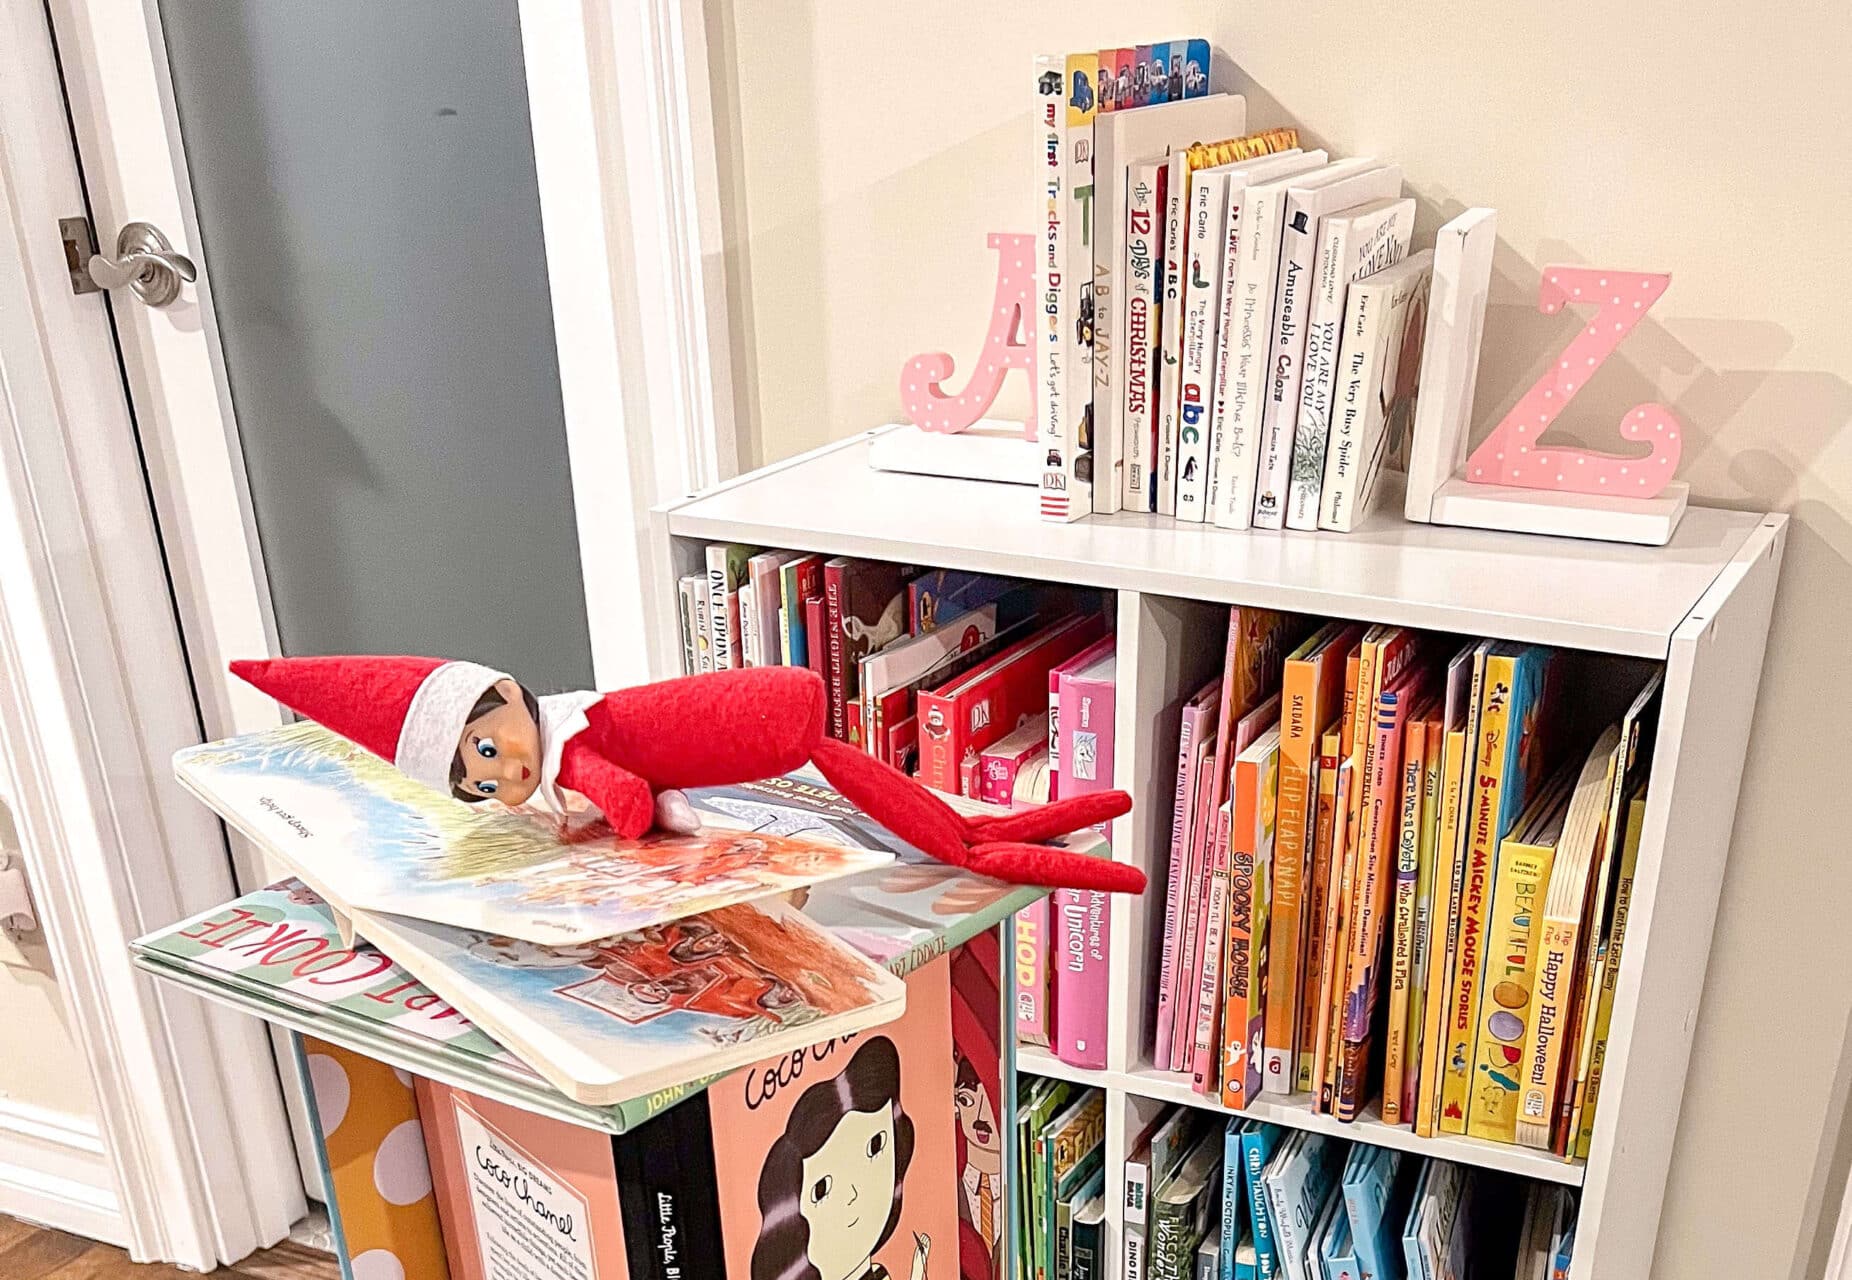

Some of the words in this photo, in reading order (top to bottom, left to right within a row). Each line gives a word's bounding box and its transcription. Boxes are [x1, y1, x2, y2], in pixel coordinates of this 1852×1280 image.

[1044, 103, 1056, 128] my
[1199, 186, 1209, 207] Eric
[1130, 208, 1151, 235] 12
[1048, 243, 1058, 269] and
[1280, 260, 1303, 346] Amuseable
[1306, 334, 1320, 373] LOVE
[1322, 321, 1335, 353] YOU
[1048, 352, 1060, 378] Let's
[1094, 327, 1110, 388] JAY-Z
[1317, 353, 1331, 388] ARE
[1350, 351, 1364, 376] The
[1303, 375, 1316, 408] YOU
[1314, 388, 1328, 413] MY
[1345, 379, 1361, 405] Very
[1047, 400, 1063, 438] driving!
[1182, 382, 1205, 444] abc
[1340, 408, 1357, 435] Busy
[1337, 440, 1353, 478] Spider
[828, 583, 838, 617] THE
[713, 614, 728, 658] UPON
[828, 619, 840, 674] NIGHT
[831, 676, 843, 738] BEFORE
[971, 701, 990, 732] DK
[796, 782, 846, 803] PETE
[1283, 764, 1305, 802] FLIP
[1362, 743, 1375, 808] SPINDERELLA
[1406, 760, 1419, 795] There
[1425, 770, 1437, 798] Zenz
[1369, 798, 1383, 853] Construction
[1405, 795, 1418, 819] Was
[1475, 773, 1498, 846] 5-MINUTE
[1279, 808, 1300, 854] FLAP
[1401, 827, 1416, 871] Coyote
[1367, 854, 1377, 871] Site
[1230, 851, 1254, 934] SPOOKY
[1365, 872, 1375, 907] Mission:
[1400, 881, 1410, 905] Who
[1464, 848, 1489, 917] MICKEY
[1622, 877, 1633, 896] How
[178, 906, 393, 986] COOKIE
[1063, 903, 1088, 973] Unicorn
[1359, 908, 1371, 956] Demolition!
[1460, 916, 1482, 977] MOUSE
[1505, 881, 1537, 977] BEAUTIFUL
[909, 934, 949, 971] COOKIE
[1016, 921, 1038, 987] HOP
[1228, 937, 1250, 999] HOUSE
[1609, 941, 1623, 967] Easter
[1394, 967, 1407, 990] Flea
[1540, 949, 1564, 1002] Happy
[1602, 966, 1619, 991] Bunny
[1457, 979, 1473, 1030] STORIES
[1531, 1003, 1557, 1087] Halloween!
[744, 1045, 808, 1111] Coco
[646, 1085, 685, 1116] JOHN
[1225, 1165, 1235, 1186] INKY
[1248, 1146, 1260, 1175] CHRIS
[475, 1144, 511, 1189] Coco
[513, 1174, 577, 1243] Chanel
[656, 1191, 676, 1225] Little
[1252, 1181, 1268, 1239] HAUGHTON
[1222, 1200, 1233, 1241] OCTOPUS
[657, 1223, 677, 1265] People,
[1057, 1226, 1069, 1269] Charlie
[1128, 1240, 1137, 1268] DINO
[1156, 1218, 1171, 1276] Wonder
[1165, 1216, 1180, 1264] FUSCO
